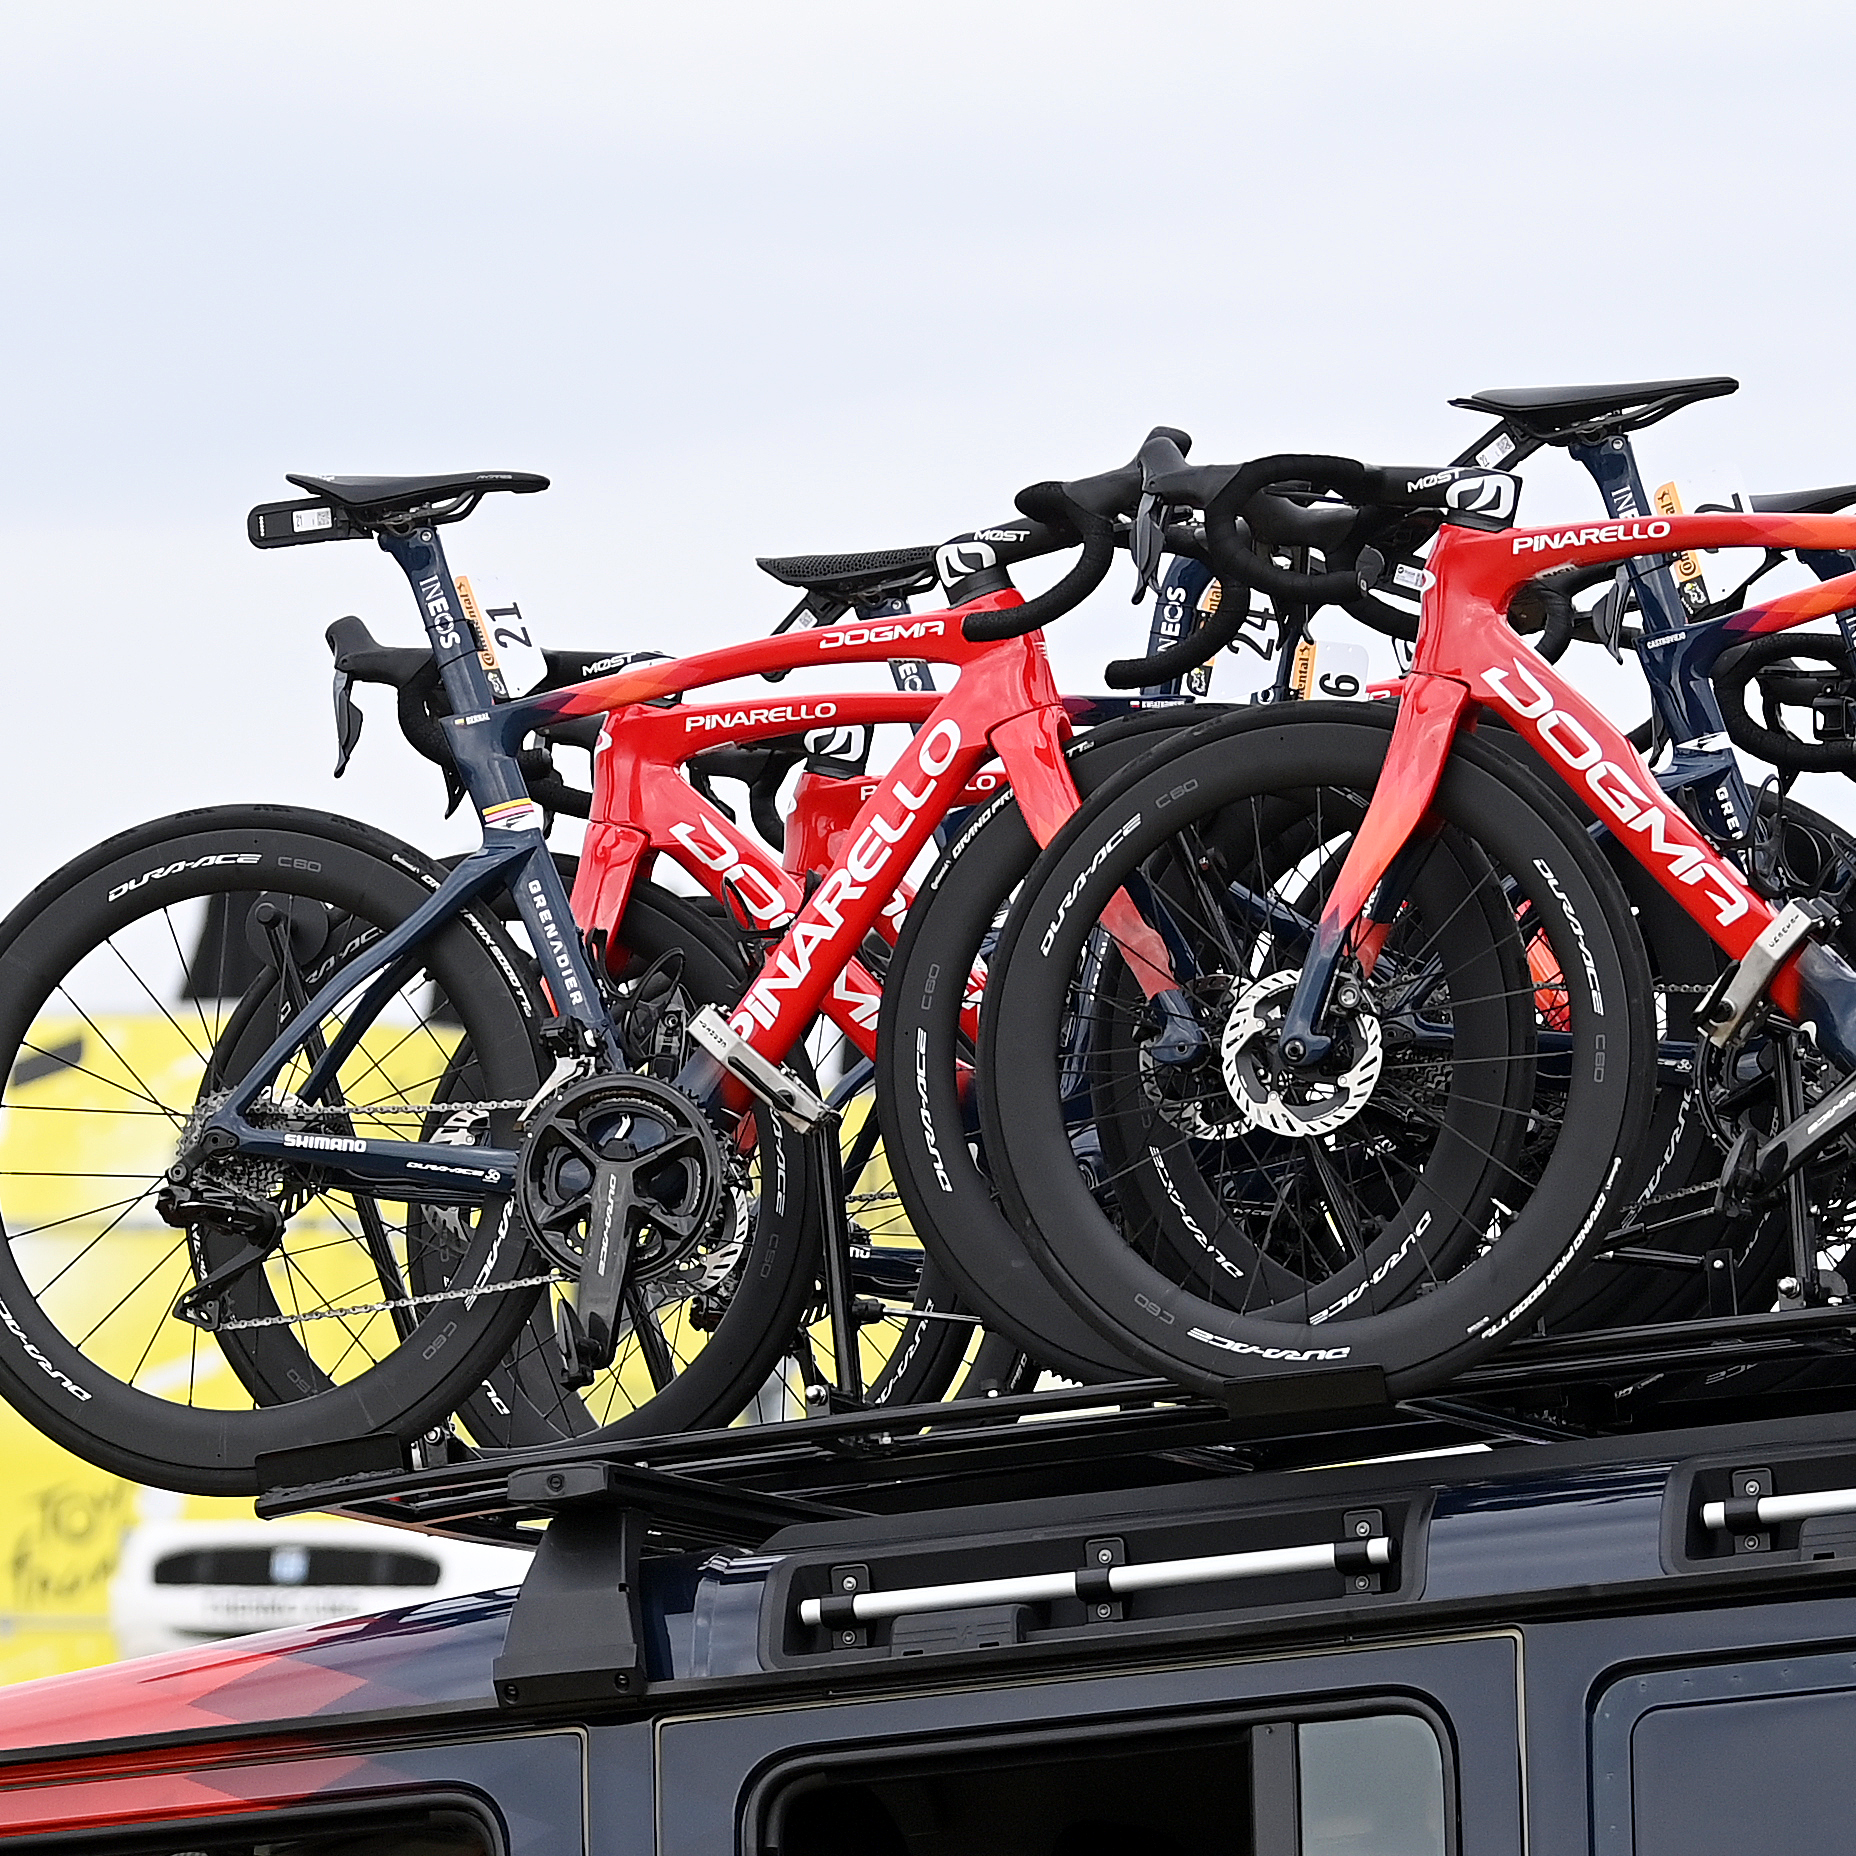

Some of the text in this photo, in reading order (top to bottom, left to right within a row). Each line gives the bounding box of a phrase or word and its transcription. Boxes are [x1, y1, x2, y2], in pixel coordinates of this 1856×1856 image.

[1511, 520, 1671, 556] PINARELLO
[418, 573, 462, 650] INEOS
[484, 600, 534, 650] 21
[818, 620, 946, 651] DOGMA
[1156, 584, 1188, 652] NEOS
[1226, 607, 1279, 661] 24
[684, 700, 838, 734] PINARELLO
[1479, 655, 1751, 929] DOGMA
[107, 851, 322, 904] DURA-ACE C60
[728, 718, 962, 1043] PINARELLO
[1040, 777, 1200, 957] DURA-ACE C60
[527, 879, 584, 1006] GRENADIER
[1532, 857, 1608, 1084] DURA-ACE C60
[914, 962, 954, 1194] DURA-ACE C60
[282, 1133, 367, 1153] SHIMANO
[1573, 1191, 1608, 1252] GRAND
[1308, 1210, 1433, 1325] DURA-ACE
[1545, 1246, 1576, 1288] PRIX
[1506, 1280, 1547, 1327] 5000
[1186, 1325, 1352, 1363] DURA-ACE
